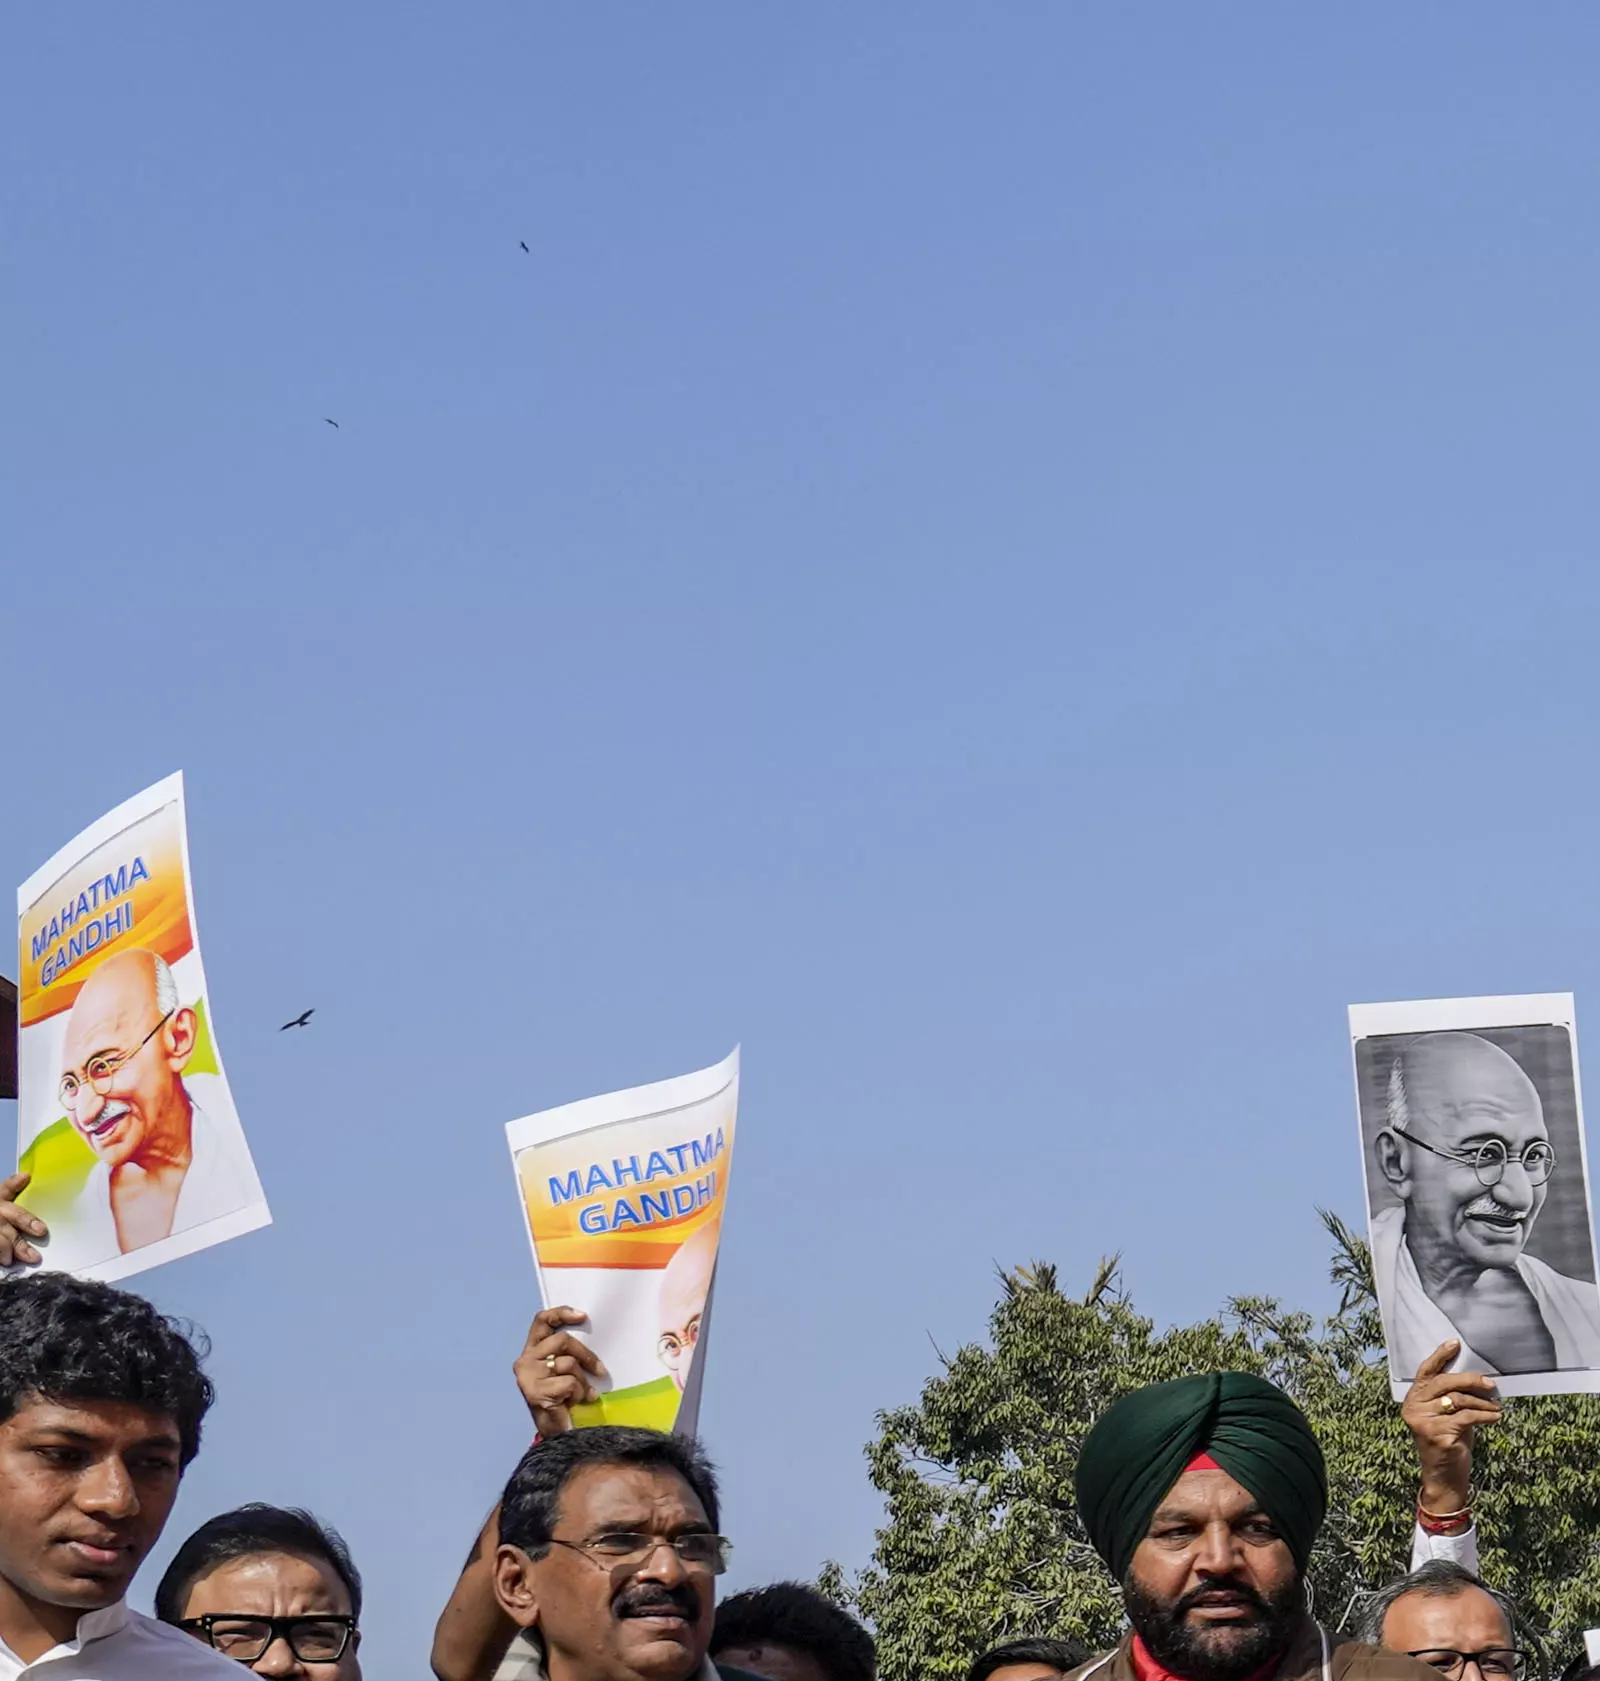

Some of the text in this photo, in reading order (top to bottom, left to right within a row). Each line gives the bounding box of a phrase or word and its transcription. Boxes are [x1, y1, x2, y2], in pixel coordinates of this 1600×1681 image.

[32, 856, 150, 962] MAHATMA
[41, 900, 133, 986] GANDHI
[548, 1127, 725, 1205] MAHATMA
[579, 1171, 717, 1235] GANDHI
